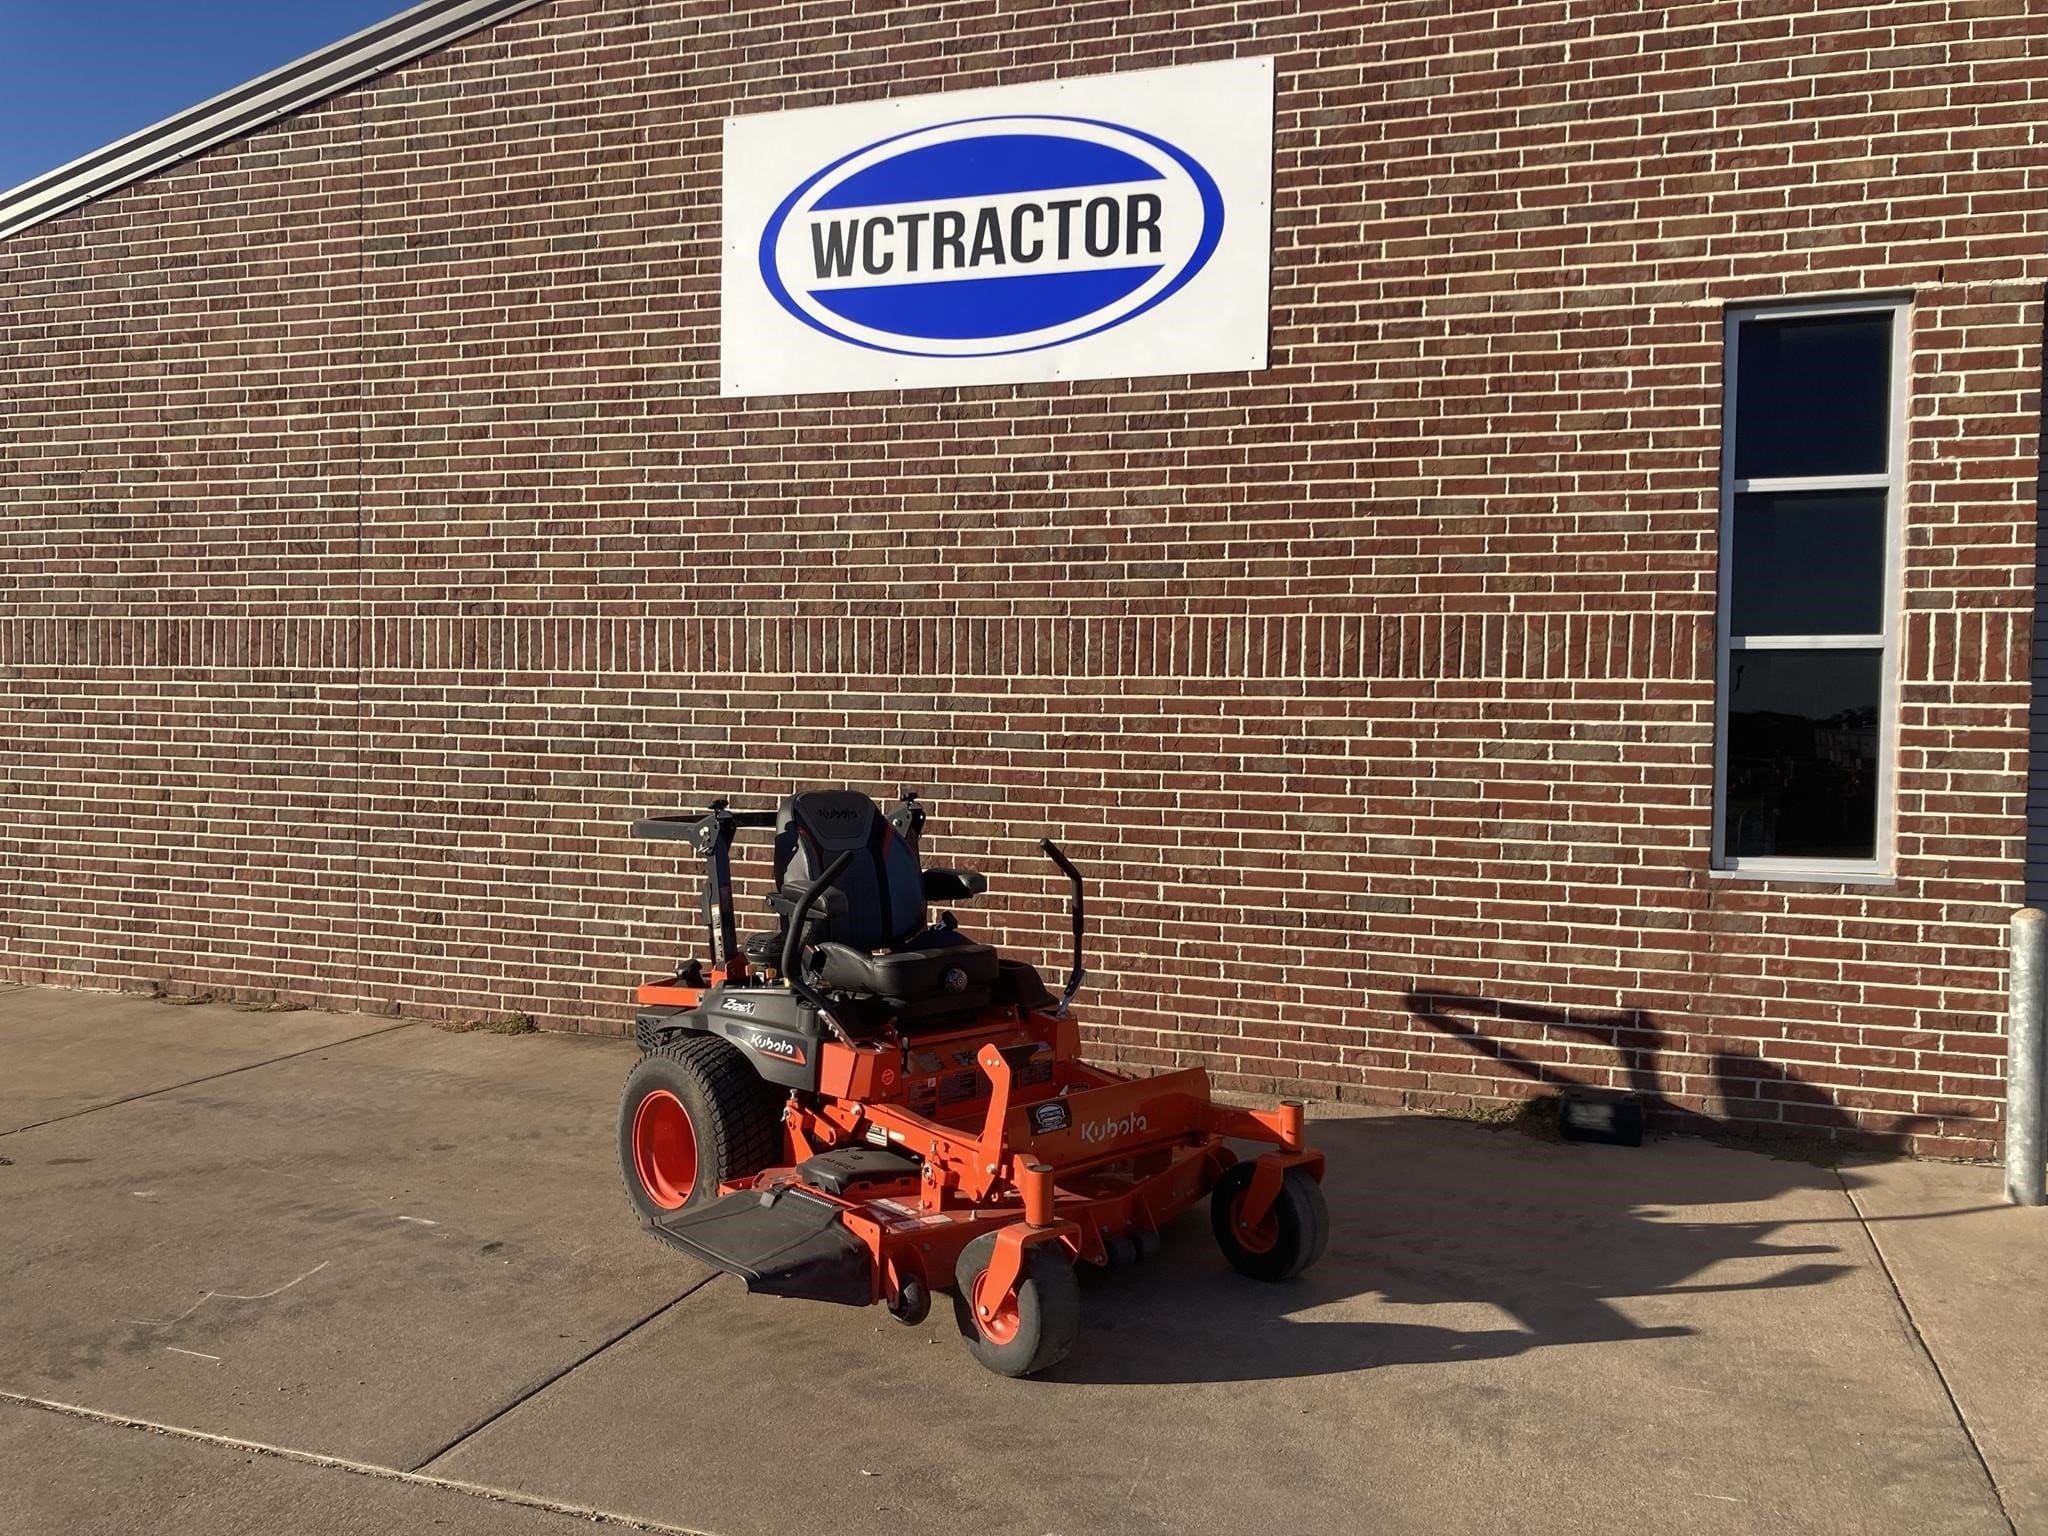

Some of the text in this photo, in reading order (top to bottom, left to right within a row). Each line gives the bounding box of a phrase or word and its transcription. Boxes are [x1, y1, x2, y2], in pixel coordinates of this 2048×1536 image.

[810, 192, 1163, 280] WCTRACTOR
[818, 808, 859, 820] Kubota
[750, 1034, 794, 1055] Kubota
[1081, 1111, 1148, 1144] Kubota
